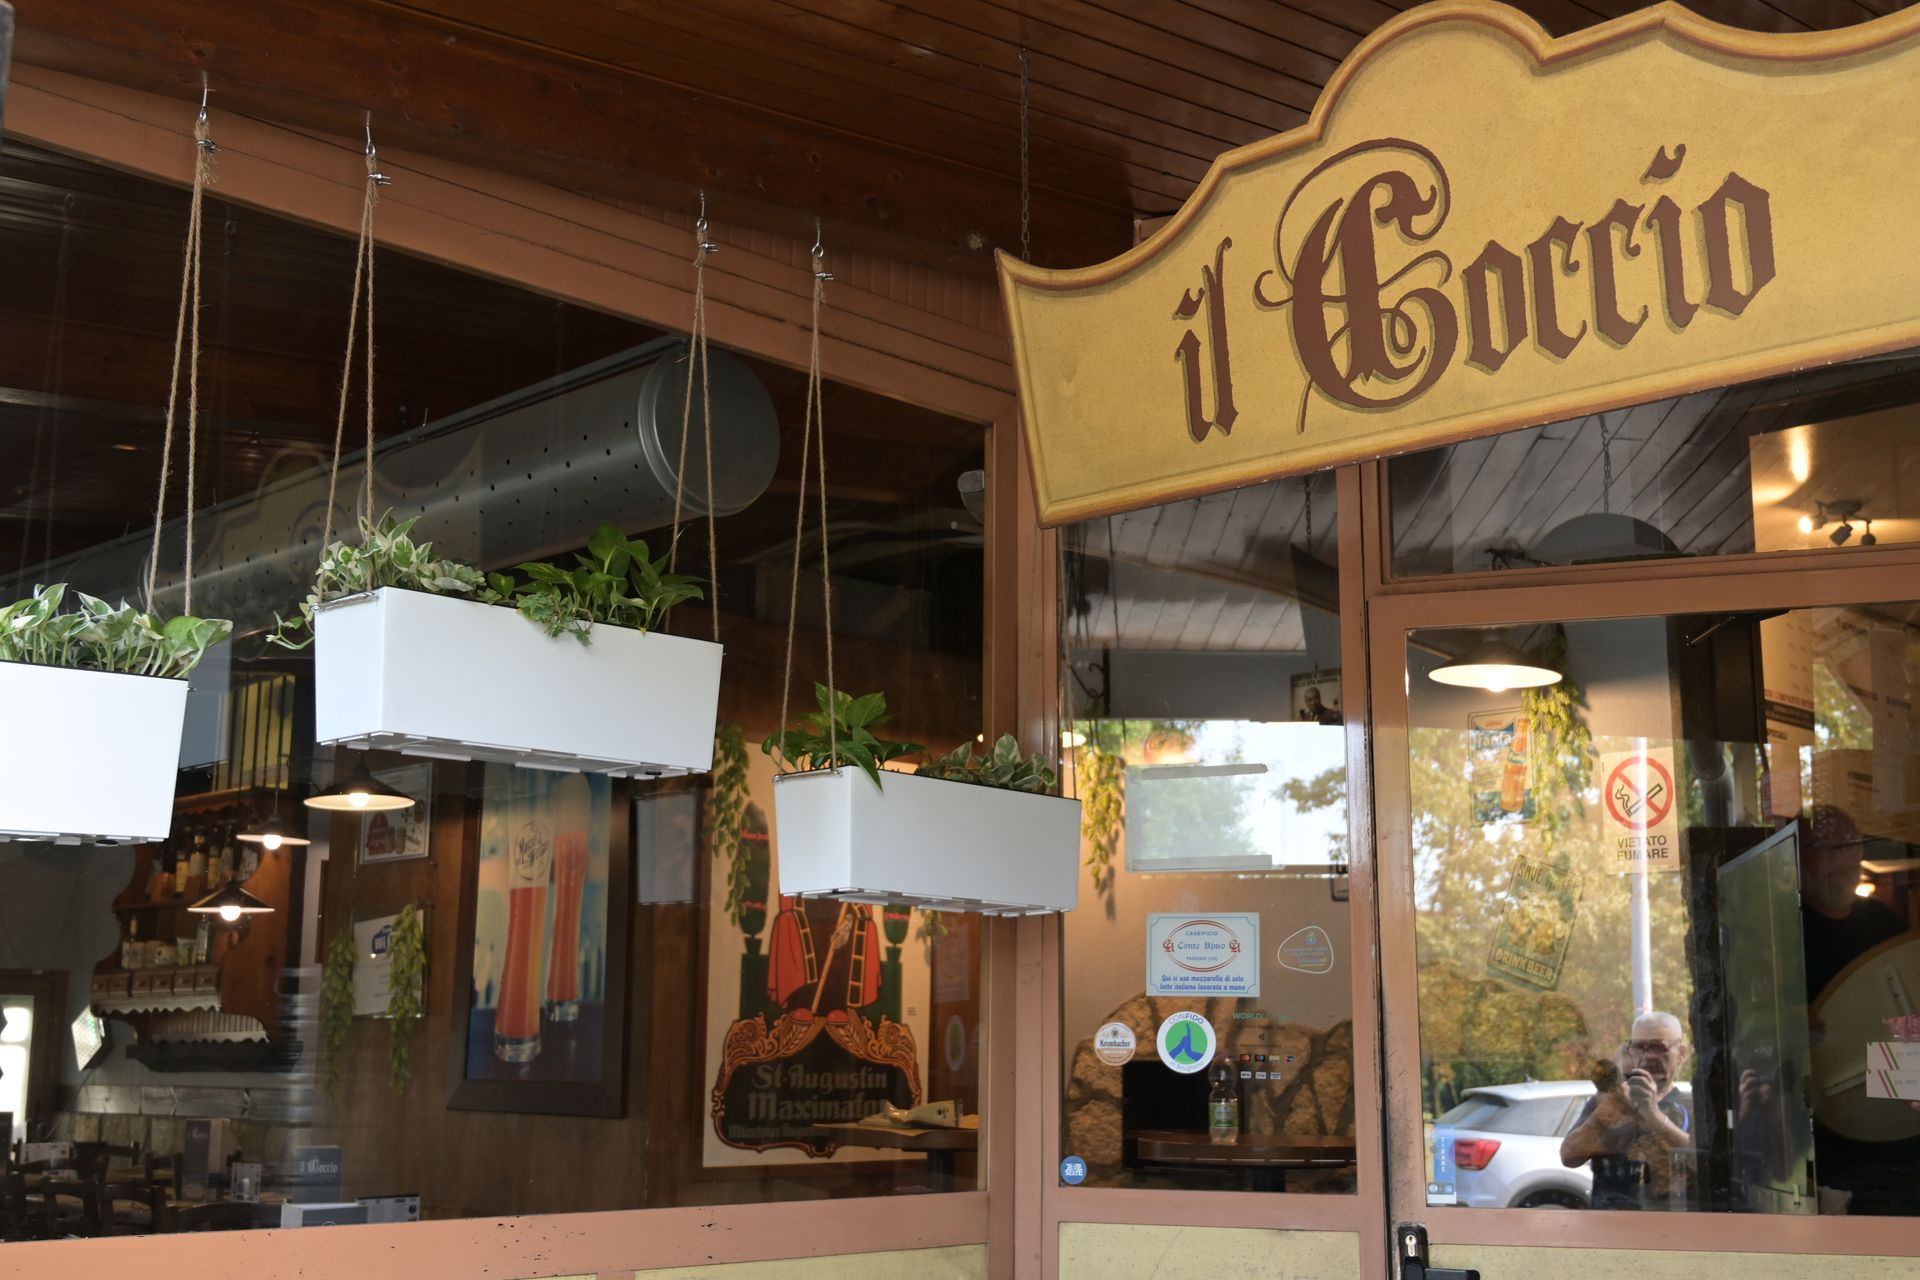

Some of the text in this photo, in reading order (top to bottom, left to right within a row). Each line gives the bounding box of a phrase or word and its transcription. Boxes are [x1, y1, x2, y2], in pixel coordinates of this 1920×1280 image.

[1174, 137, 1777, 442] il Coccio
[1616, 835, 1667, 848] VIETATO
[1616, 848, 1669, 861] FUMARE
[1517, 862, 1544, 883] SAVE
[1495, 948, 1554, 981] DRINK BEER
[1169, 1012, 1204, 1025] CONFIDO
[1100, 1039, 1132, 1048] Krombacher
